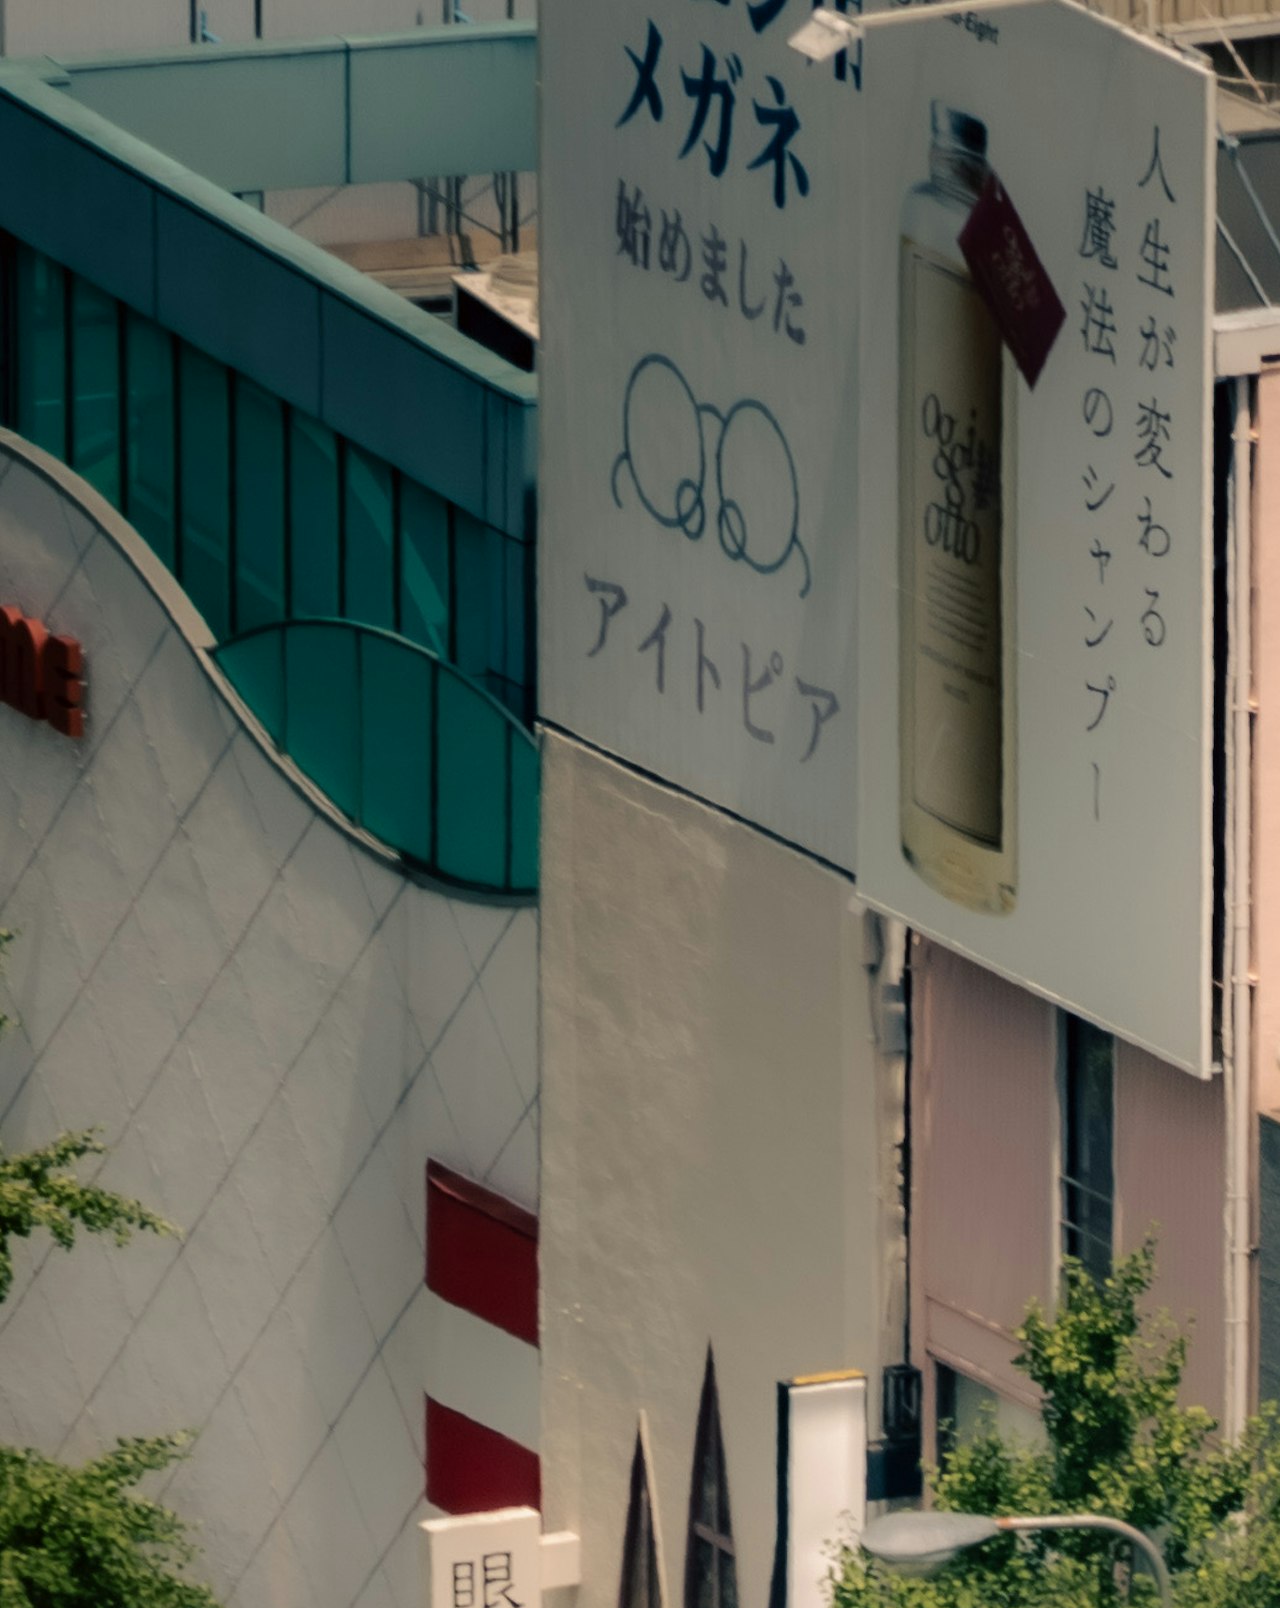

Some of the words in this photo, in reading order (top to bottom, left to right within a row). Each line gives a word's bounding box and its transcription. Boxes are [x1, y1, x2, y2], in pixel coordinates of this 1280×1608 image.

[615, 18, 810, 209] メガネ
[615, 178, 806, 345] 始めました
[1136, 125, 1175, 647] 人生が変わる
[1078, 185, 1118, 822] 魔法のシャンプー
[583, 570, 840, 762] アイトピア
